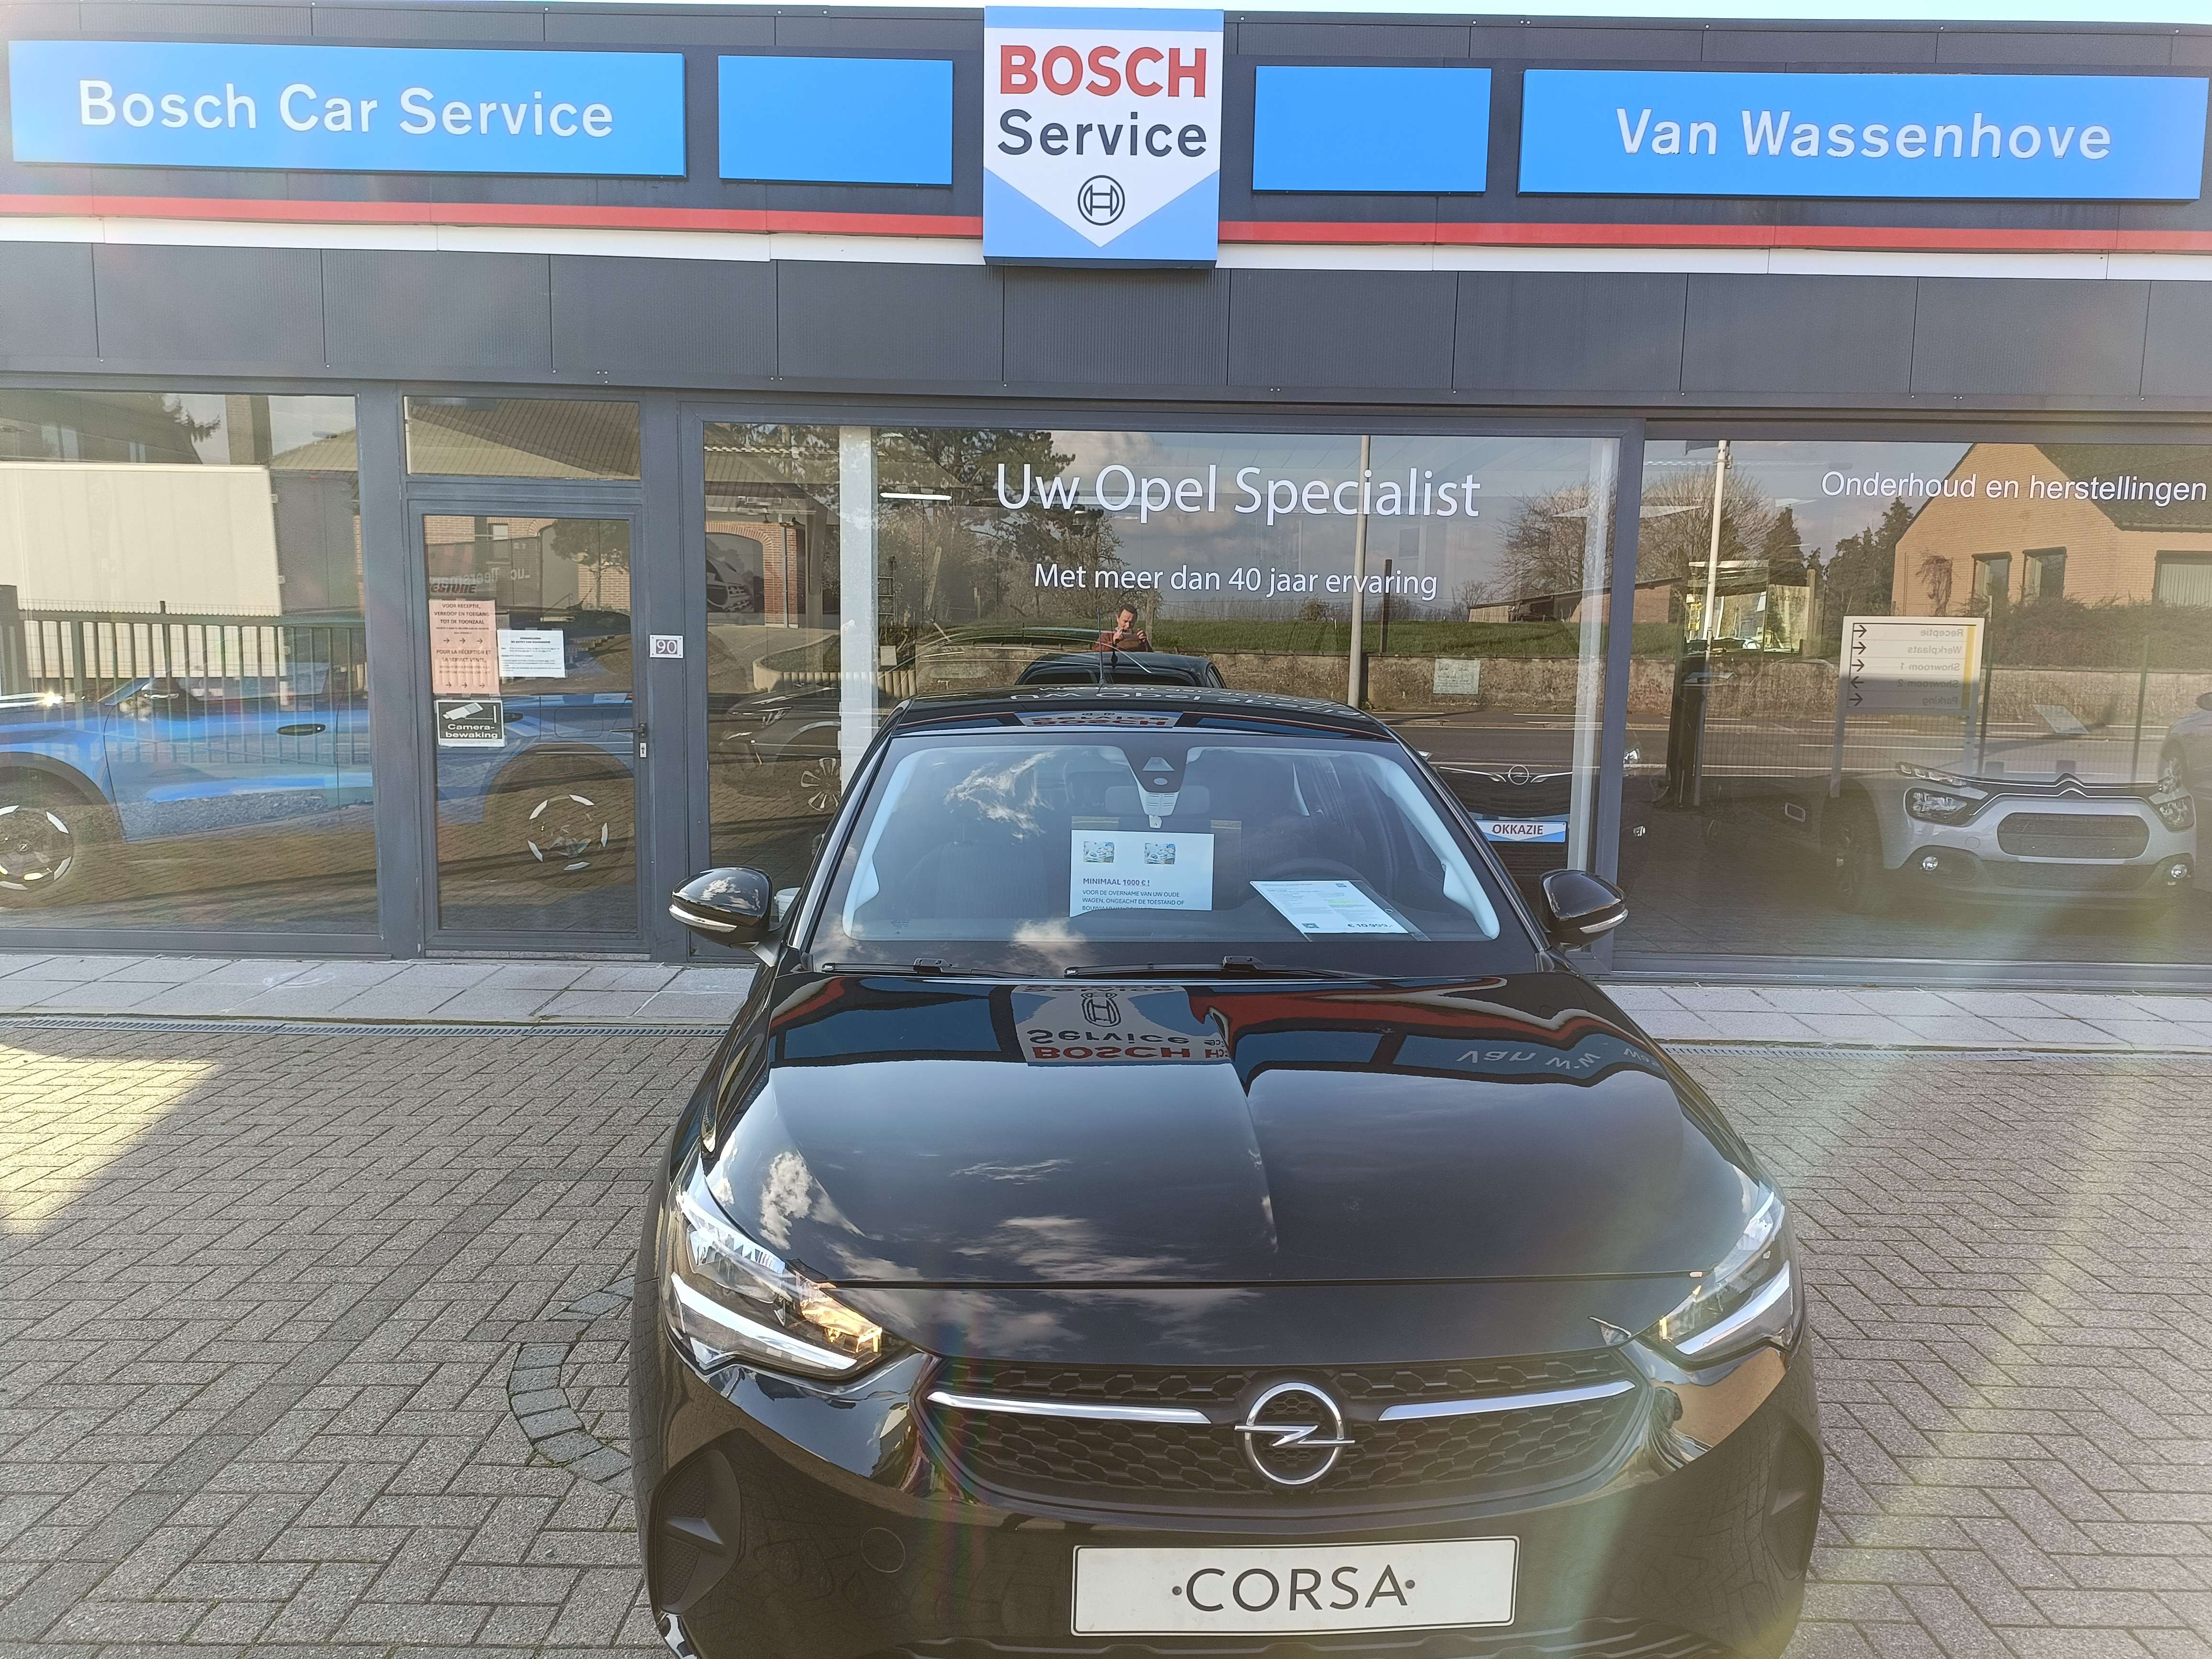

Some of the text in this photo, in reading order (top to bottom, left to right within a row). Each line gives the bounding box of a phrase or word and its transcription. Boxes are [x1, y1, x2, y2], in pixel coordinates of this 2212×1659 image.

[1000, 45, 1206, 98] BOSCH
[78, 79, 613, 137] Bosch Car Service
[997, 109, 1206, 157] Service
[1616, 108, 2112, 160] Van Wassenhove
[997, 463, 1481, 526] Uw Opel Specialist
[1821, 471, 2207, 507] Onderhoud en herstellingen
[429, 583, 476, 593] ESTONE
[1034, 564, 1437, 601] Met meer dan 40 jaar ervaring
[656, 640, 677, 654] 90
[1492, 824, 1543, 835] OKKAZIE
[1185, 1564, 1408, 1612] CORSA
